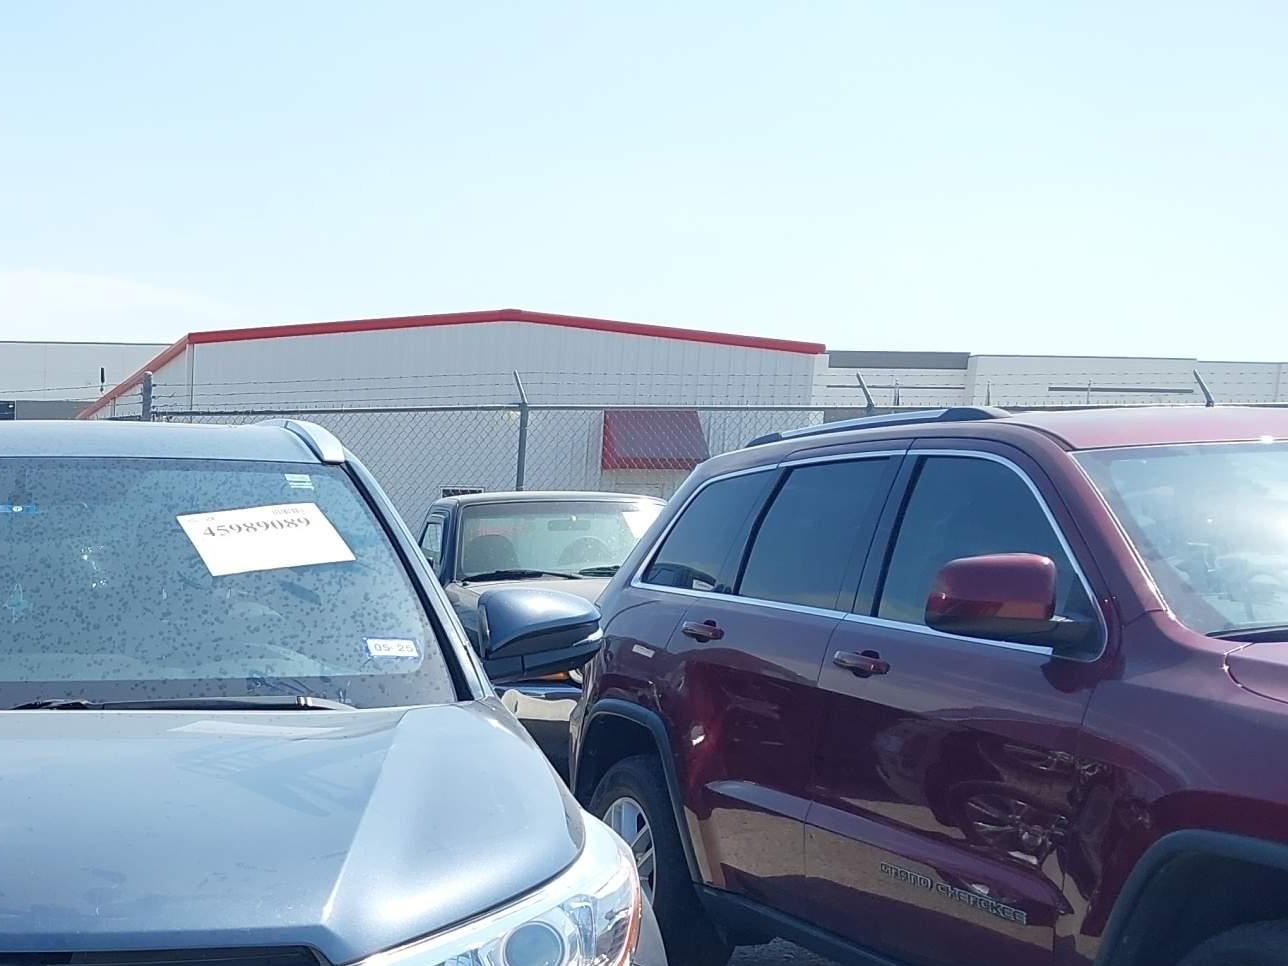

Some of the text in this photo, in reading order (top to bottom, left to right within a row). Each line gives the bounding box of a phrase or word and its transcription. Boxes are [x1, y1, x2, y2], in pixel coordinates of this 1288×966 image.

[202, 516, 311, 537] 45989089
[880, 861, 1028, 924] GRAND CHEROKEE
